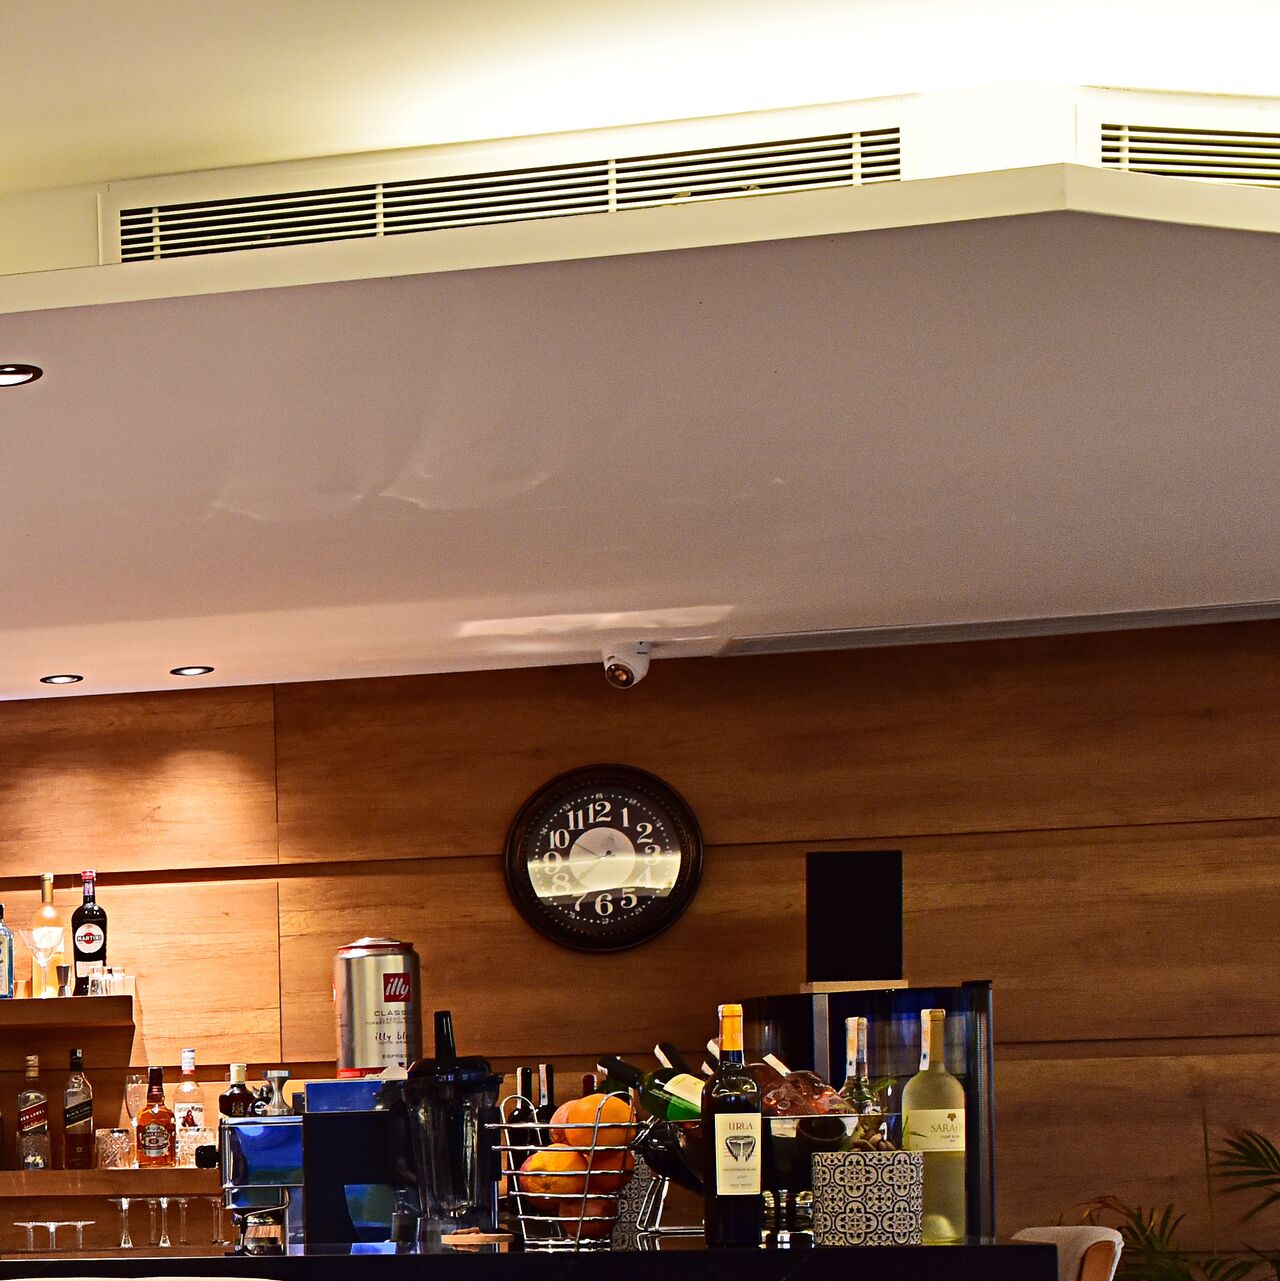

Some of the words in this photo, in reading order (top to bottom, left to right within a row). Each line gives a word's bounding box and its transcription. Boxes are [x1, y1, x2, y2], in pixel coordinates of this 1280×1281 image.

[566, 808, 584, 831] 11
[587, 800, 612, 824] 12
[620, 807, 630, 828] 1
[549, 828, 570, 850] 10
[636, 822, 653, 844] 2
[542, 851, 563, 876] 9
[645, 844, 662, 866] 3
[551, 873, 571, 895] 8
[636, 866, 653, 886] 4
[572, 892, 589, 912] 7
[594, 893, 614, 916] 6
[620, 888, 638, 909] 5
[76, 934, 102, 942] MARTINI
[385, 977, 409, 1000] illy
[375, 1032, 391, 1042] illy
[20, 1114, 30, 1122] RED
[30, 1109, 46, 1118] LABEL
[728, 1122, 754, 1131] URLA
